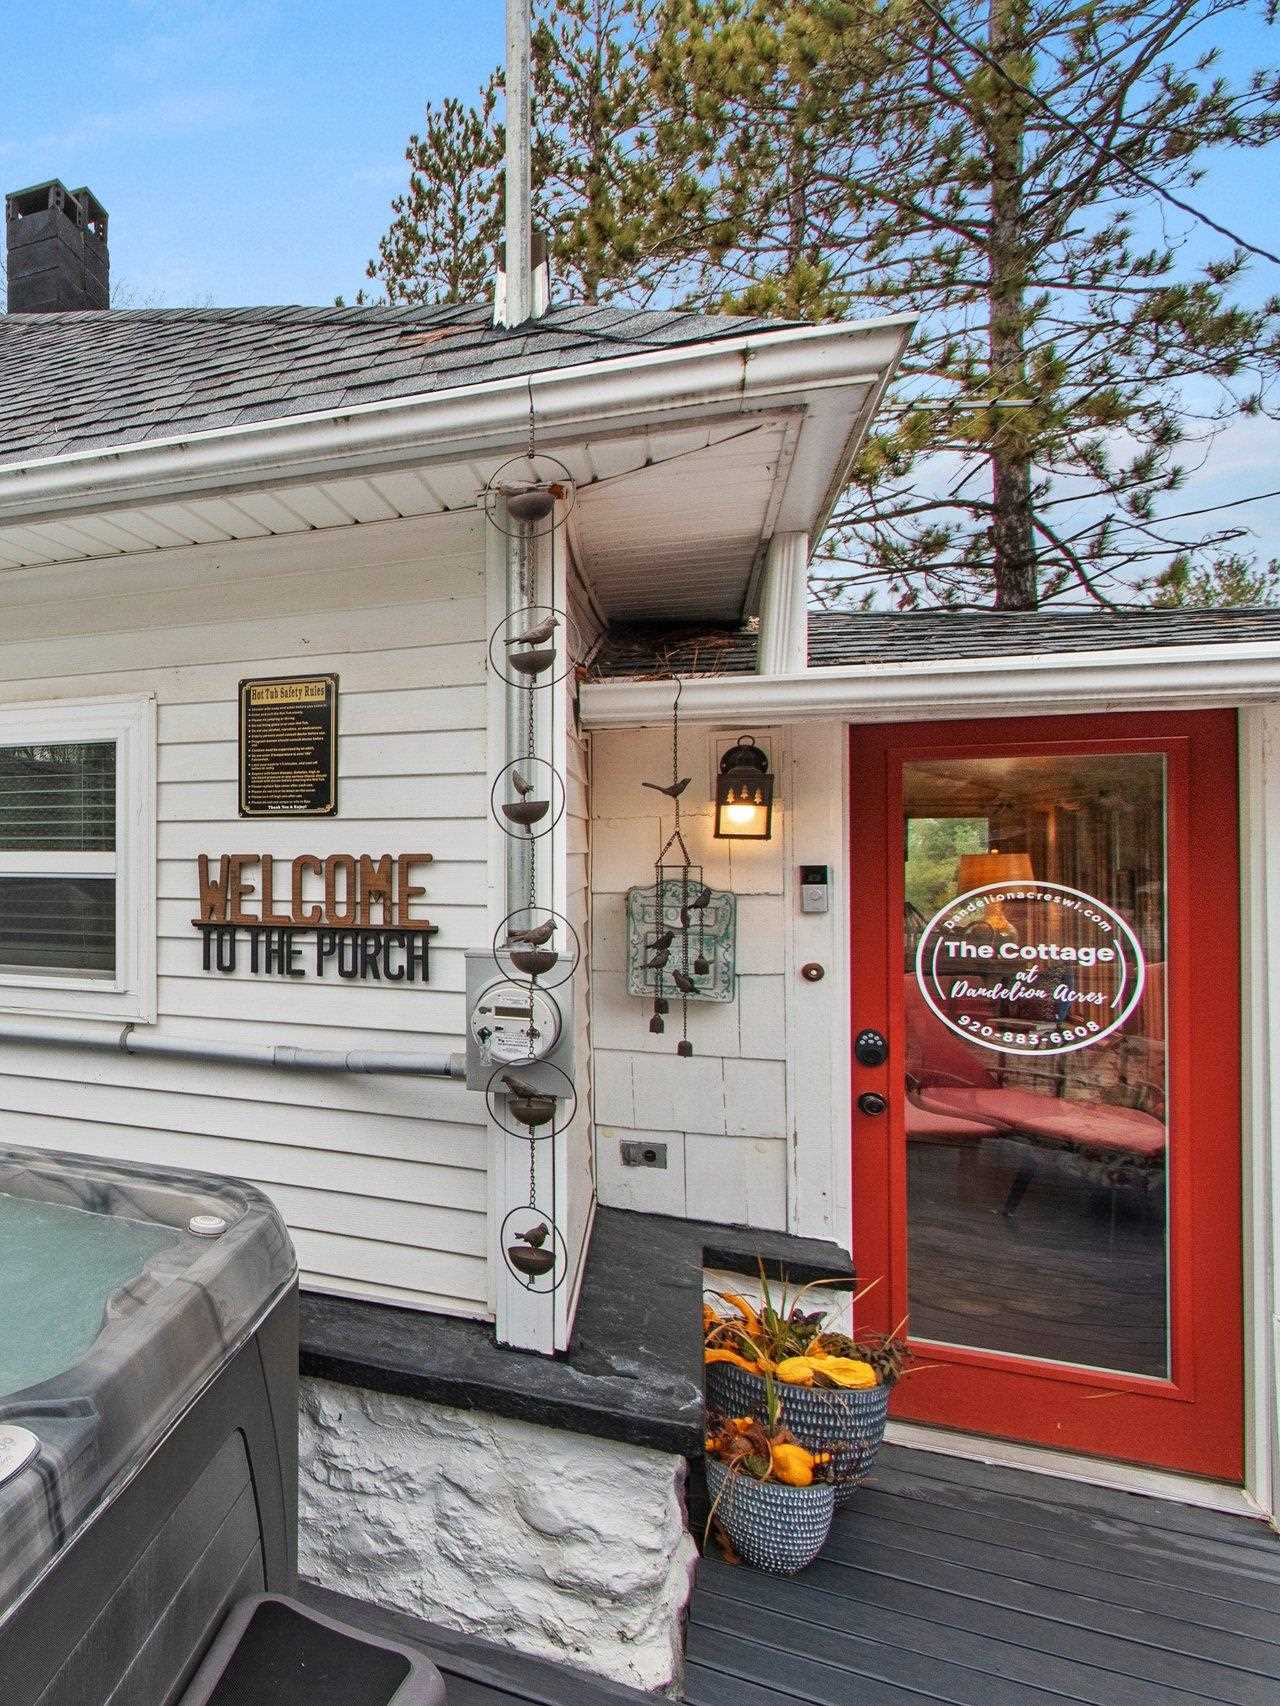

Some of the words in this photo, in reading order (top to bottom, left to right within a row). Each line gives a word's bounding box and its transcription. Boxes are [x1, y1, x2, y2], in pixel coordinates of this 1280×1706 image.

[252, 689, 264, 700] Hot
[265, 687, 278, 699] Tub
[281, 686, 302, 700] Safety
[305, 685, 324, 697] Rules
[197, 853, 433, 928] WELCOME
[943, 891, 1112, 933] Dandelionacreswi.com
[198, 926, 236, 972] TO
[245, 927, 307, 975] THE
[316, 929, 432, 982] PORCH
[944, 941, 993, 959] The
[999, 942, 1115, 967] Cottage
[1015, 964, 1039, 984] at
[951, 981, 1047, 1001] Dandelion
[1053, 984, 1107, 1005] Acres
[957, 1015, 1101, 1045] 920-883-6808
